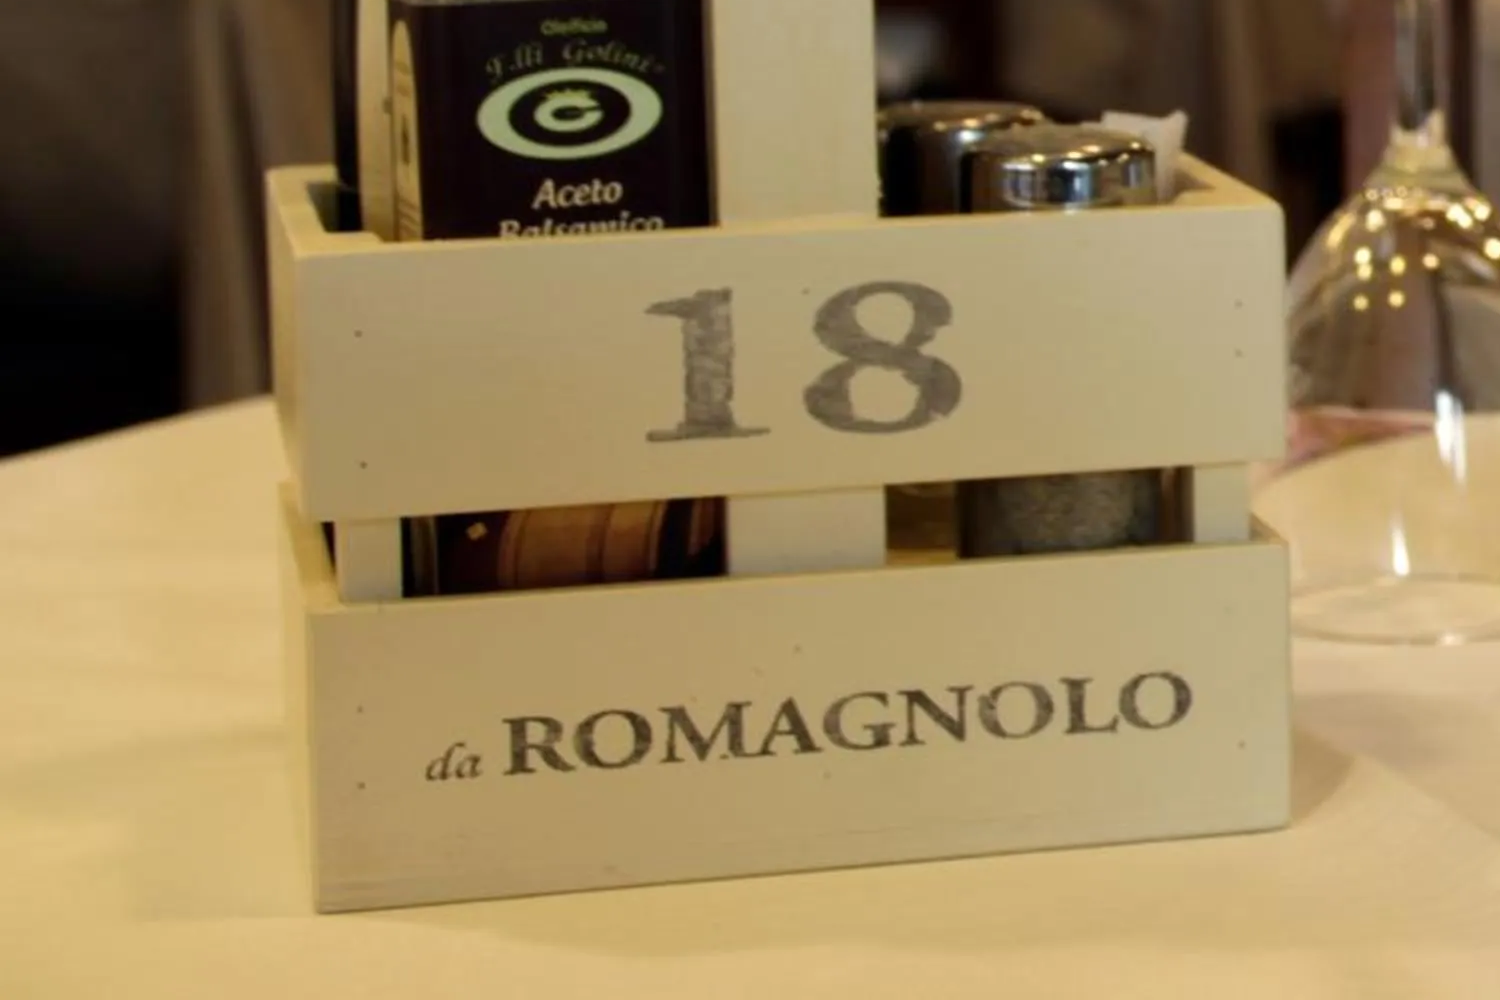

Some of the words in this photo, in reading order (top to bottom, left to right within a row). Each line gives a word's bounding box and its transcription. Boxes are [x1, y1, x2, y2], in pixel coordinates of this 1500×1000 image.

[531, 177, 624, 210] Aceto
[644, 281, 962, 442] 18
[425, 742, 482, 781] da
[502, 670, 1193, 776] ROMAGNOLO
